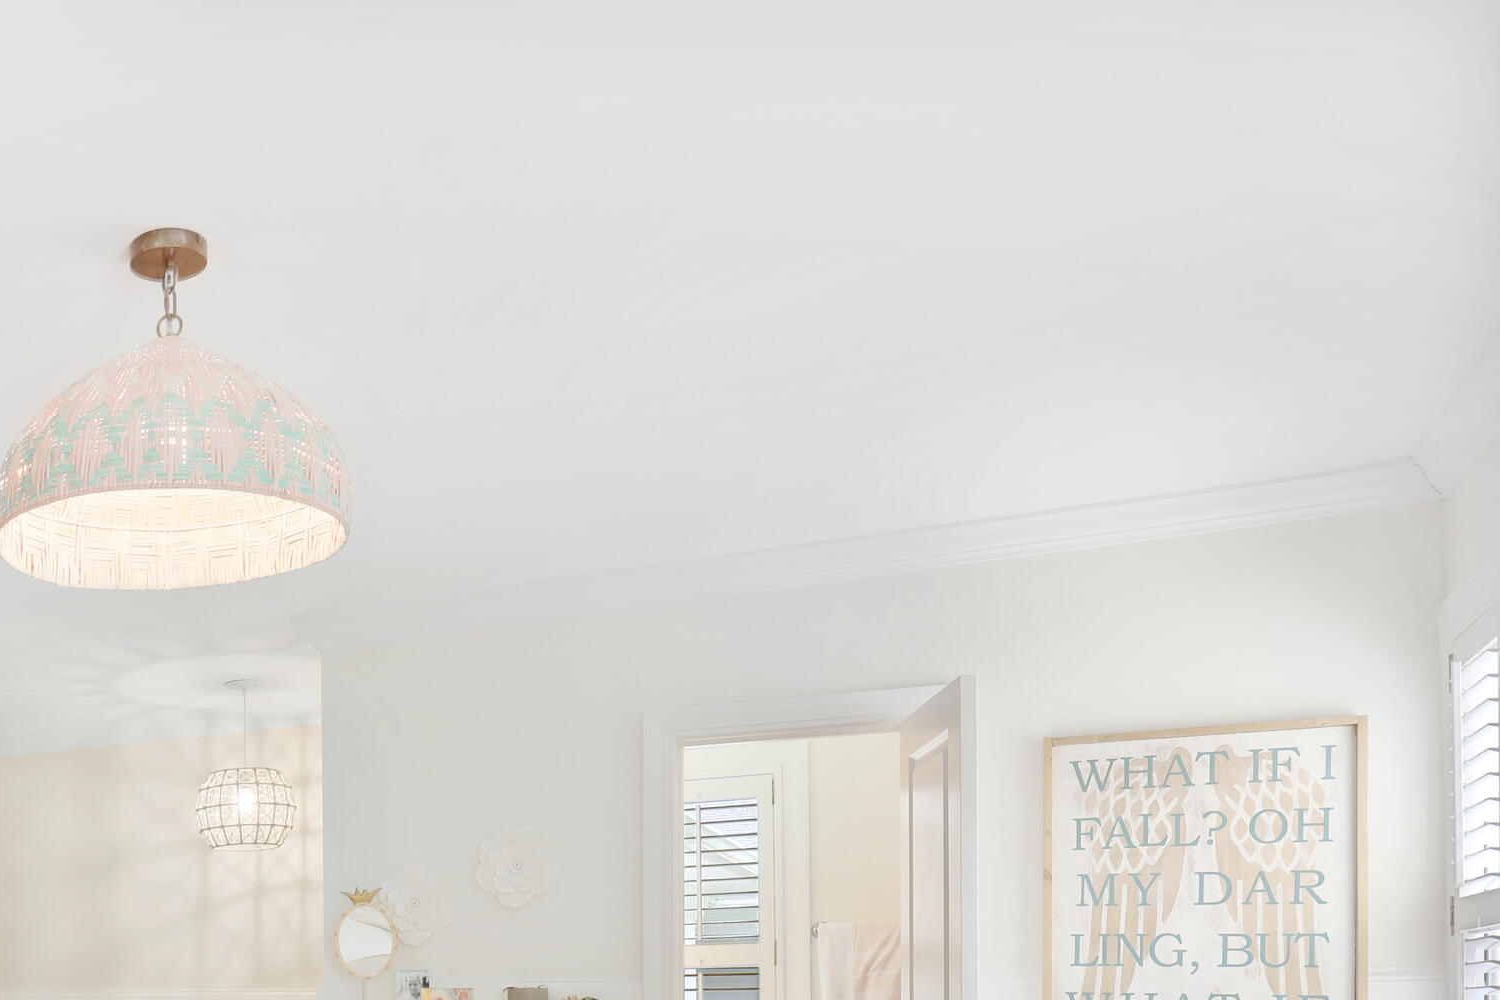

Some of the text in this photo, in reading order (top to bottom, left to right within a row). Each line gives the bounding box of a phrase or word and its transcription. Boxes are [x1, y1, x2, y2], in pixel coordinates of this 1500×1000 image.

[1069, 744, 1337, 792] WHAT IF I
[1071, 807, 1335, 851] FALL? OH
[1076, 870, 1328, 908] MY DAR
[1070, 932, 1330, 975] LING, BUT
